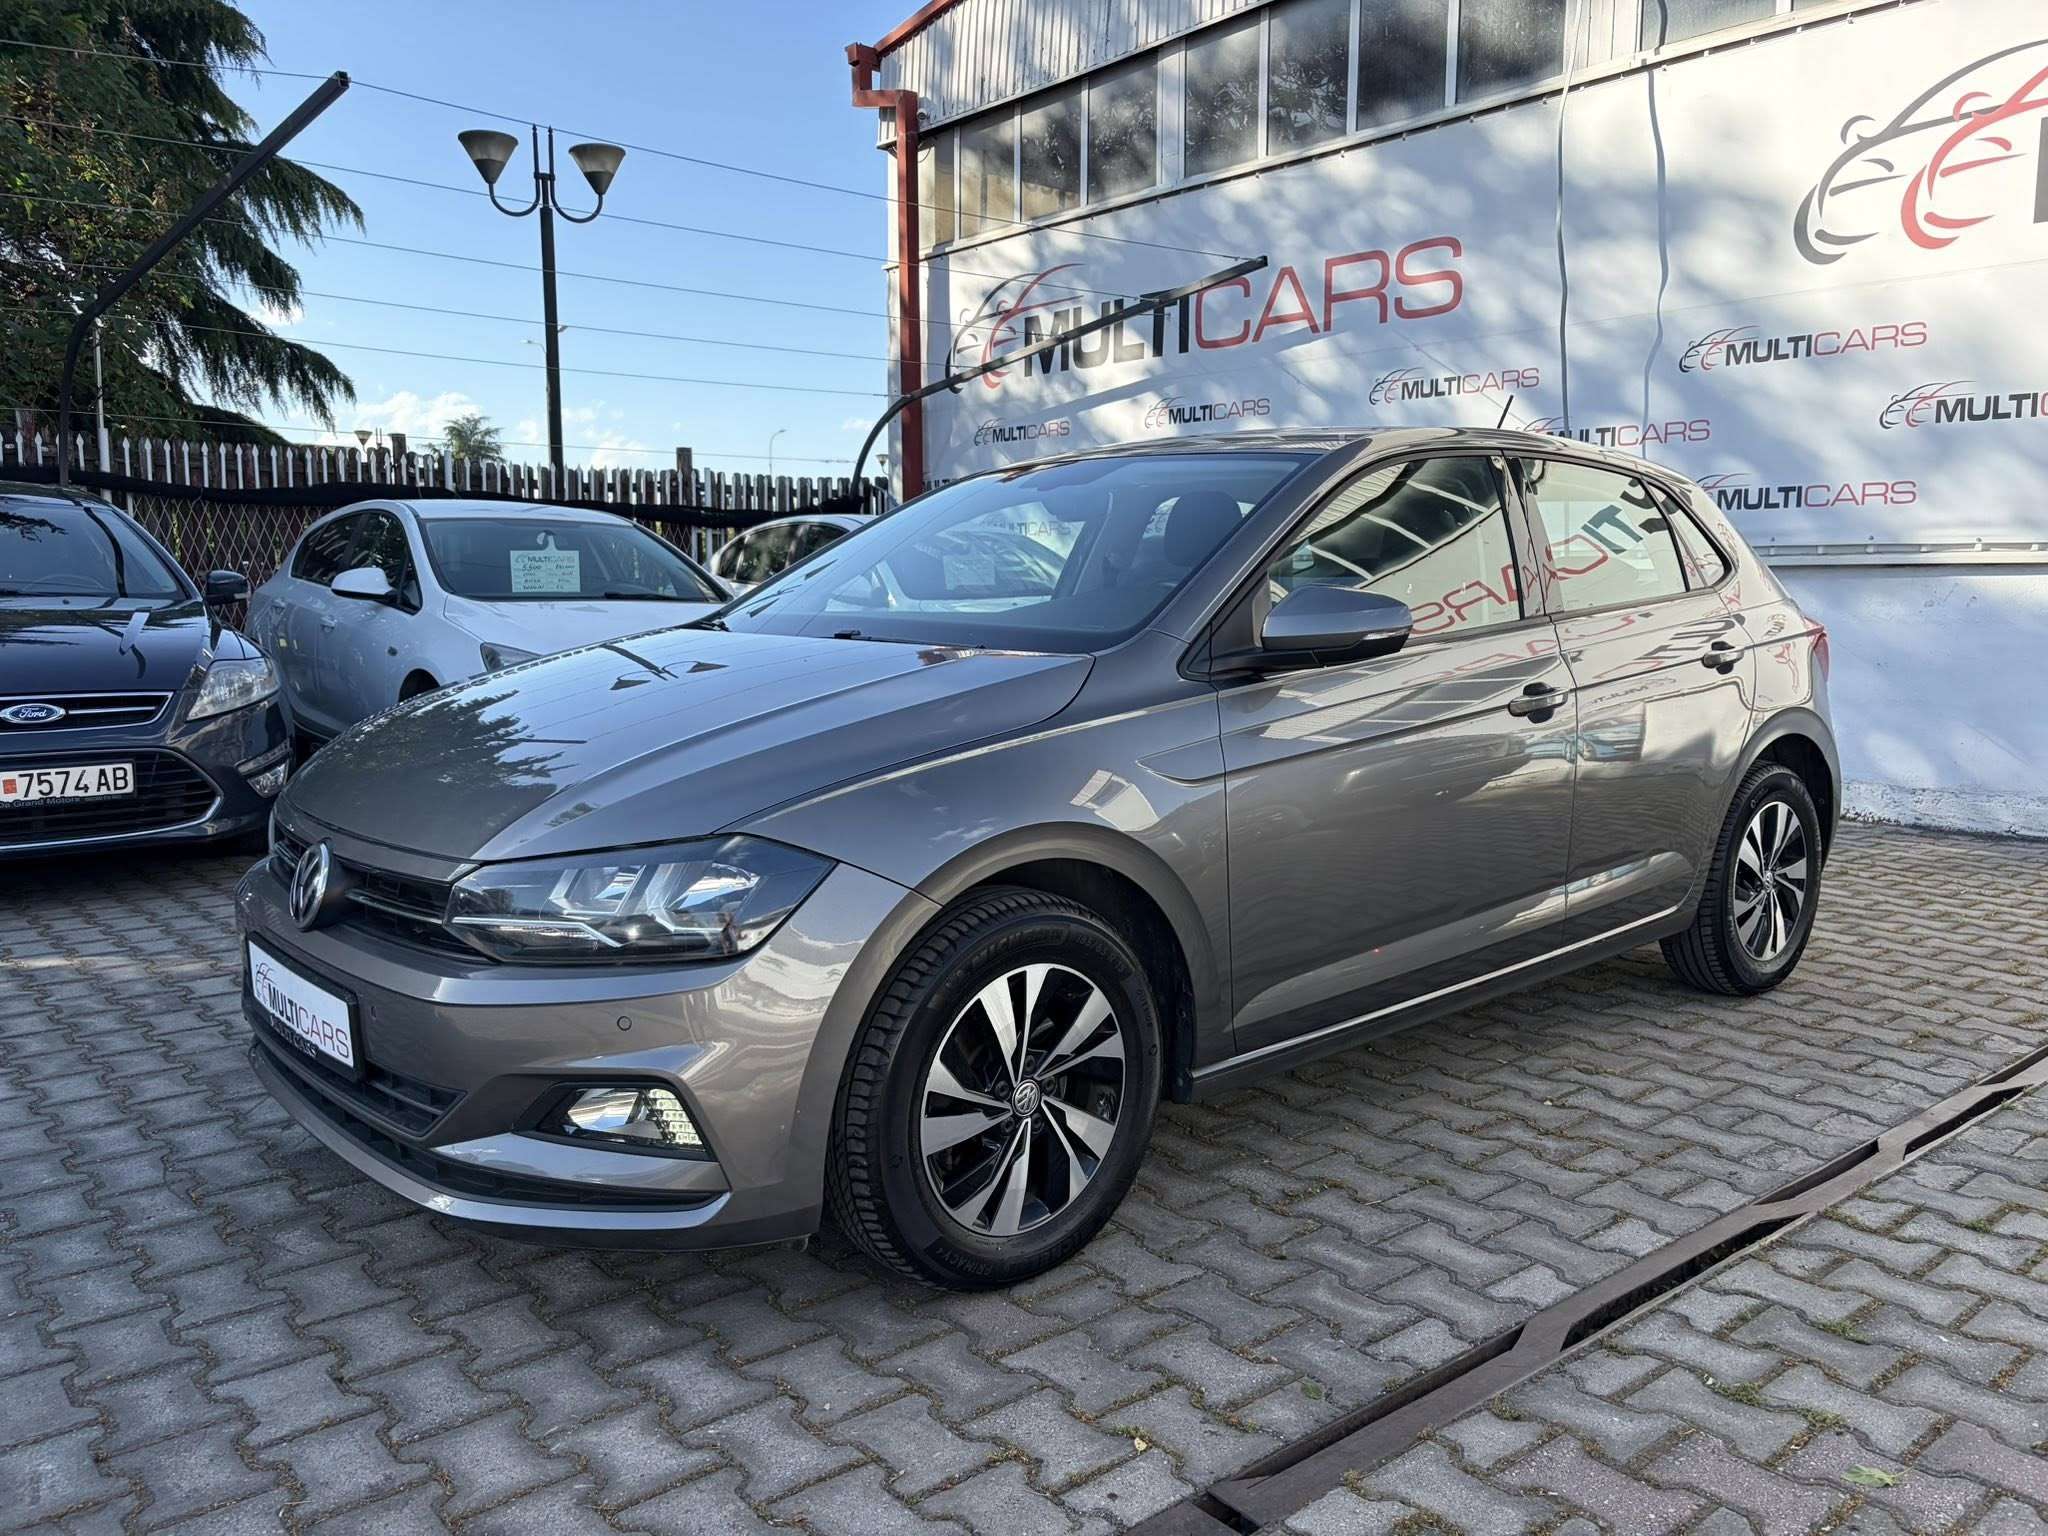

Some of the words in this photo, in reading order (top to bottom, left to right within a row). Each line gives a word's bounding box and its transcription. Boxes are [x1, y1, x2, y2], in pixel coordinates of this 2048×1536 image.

[1024, 236, 1463, 377] MULTICARS
[1726, 322, 1927, 367] MULTICARS
[1401, 368, 1540, 400] MULTICARS
[1168, 397, 1271, 424] MULTICARS
[1935, 392, 2048, 424] MULTI
[993, 420, 1070, 443] MULTICARS
[1717, 480, 1917, 511] MULTICARS
[19, 707, 47, 718] Ford
[18, 769, 90, 798] 7574
[97, 766, 128, 793] AB
[14, 798, 43, 808] Grand
[47, 795, 80, 805] Motors
[268, 983, 350, 1059] MULTICARS
